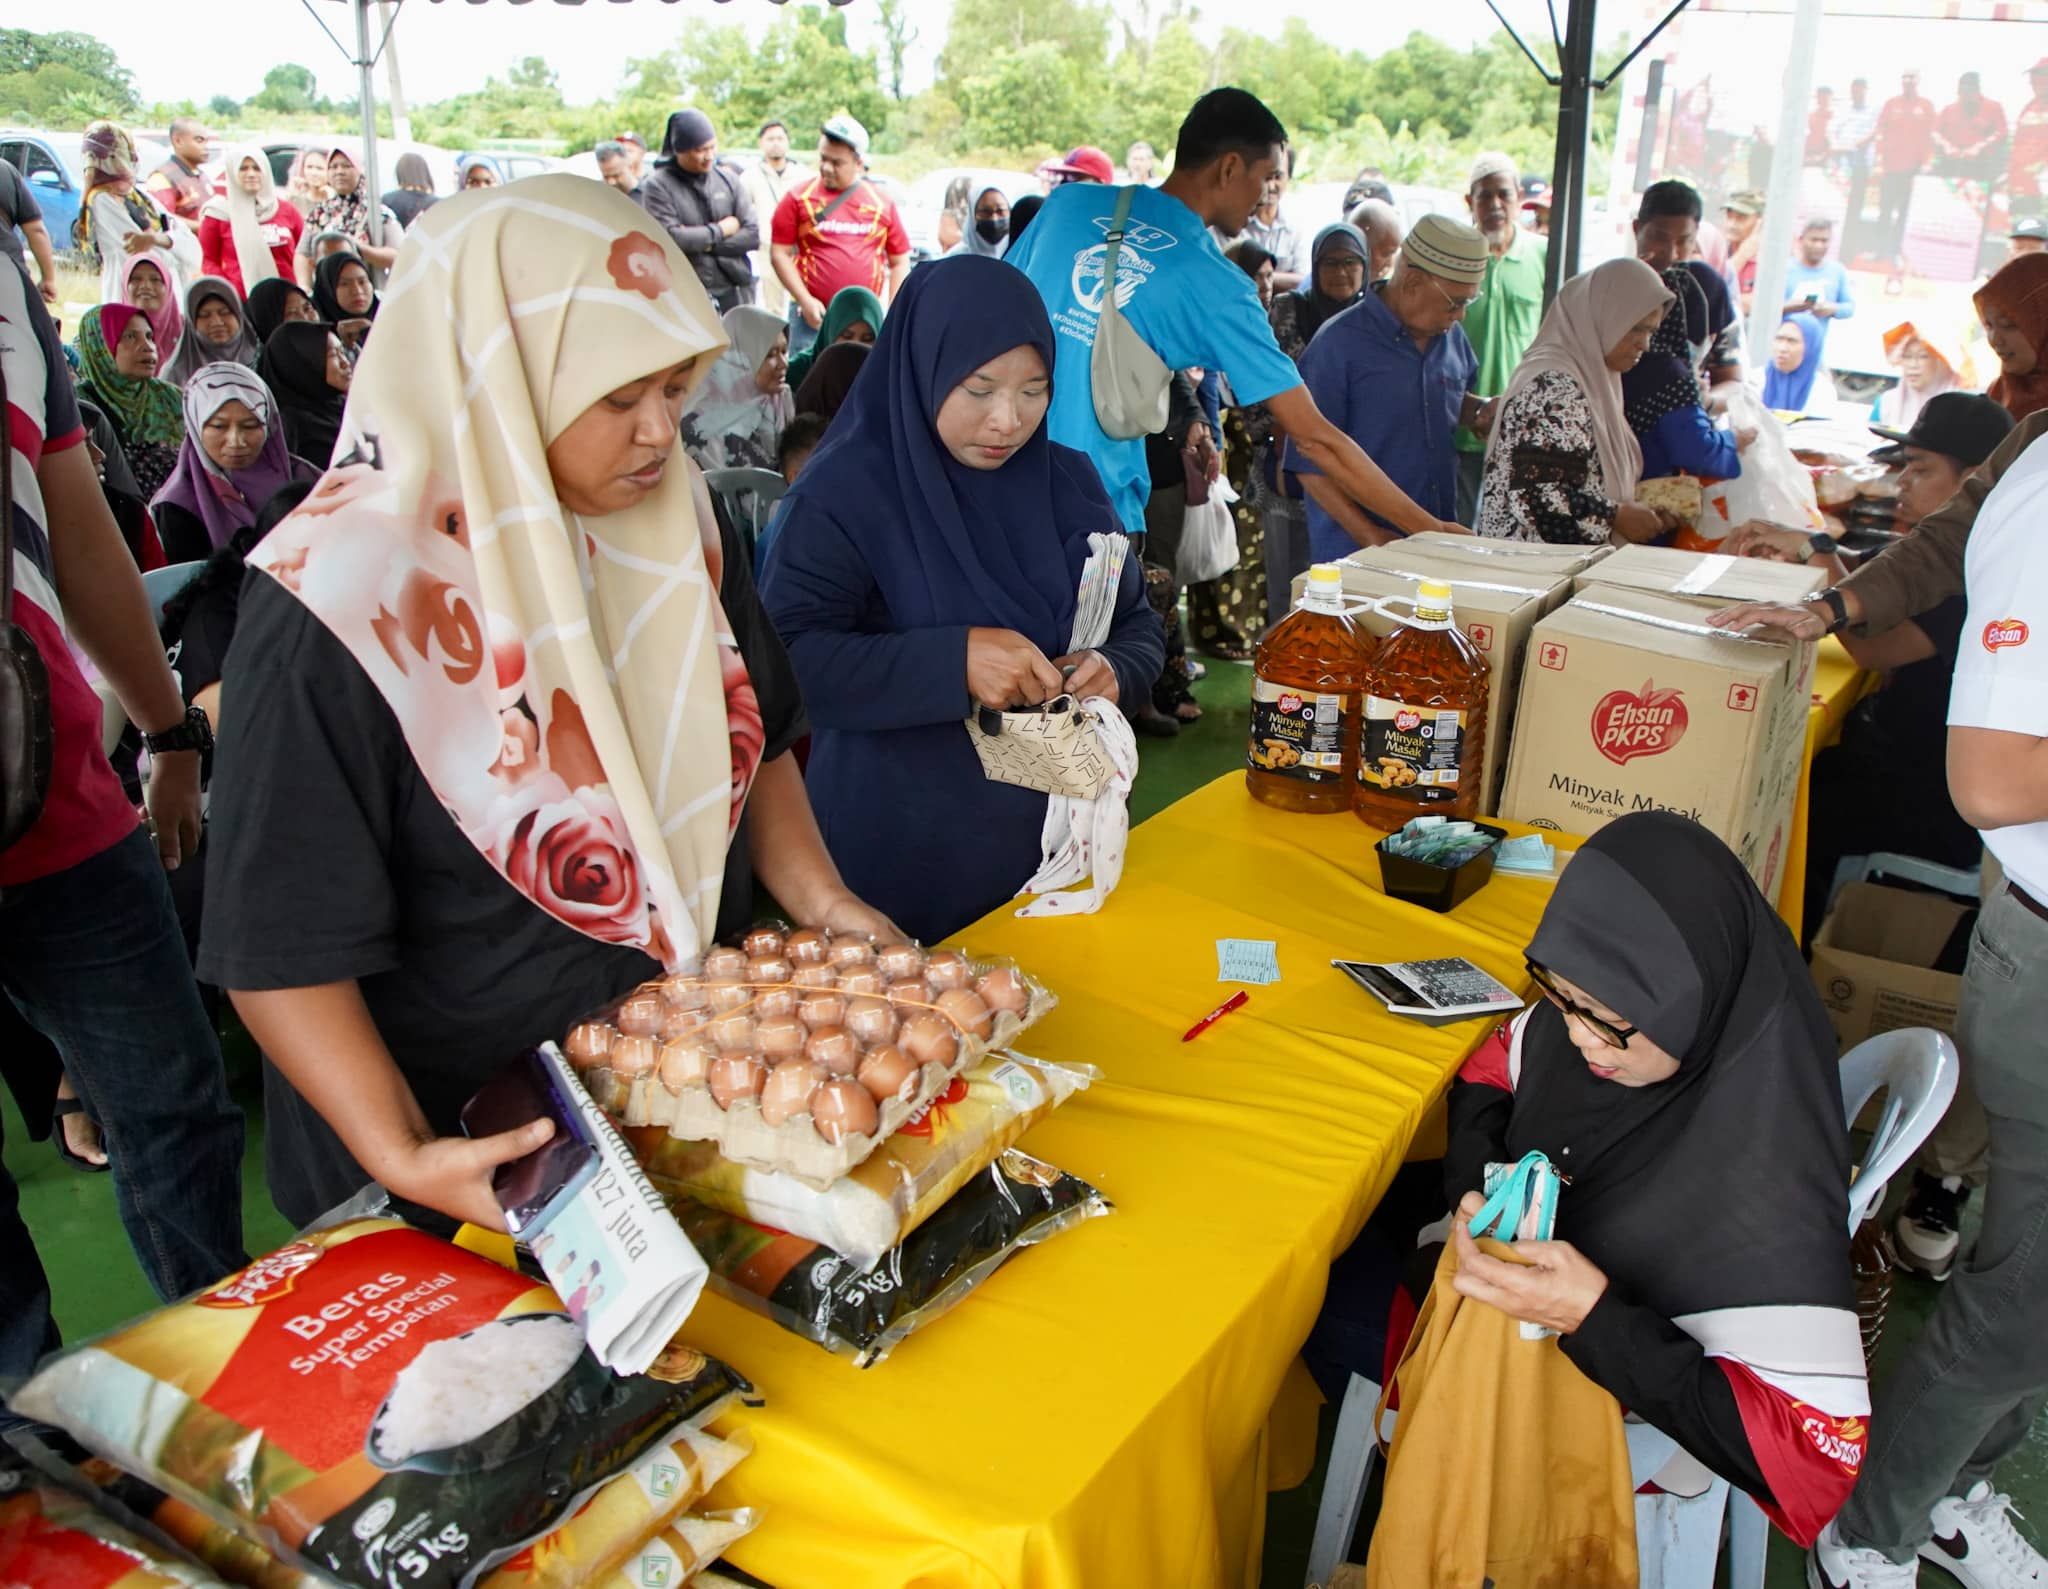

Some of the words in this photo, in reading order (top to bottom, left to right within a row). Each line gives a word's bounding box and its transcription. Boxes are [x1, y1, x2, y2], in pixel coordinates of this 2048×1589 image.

[1268, 711, 1308, 730] Minyak
[1608, 702, 1675, 727] Ehsan
[1270, 722, 1305, 739] Masak
[1384, 729, 1425, 748] Minyak
[1600, 725, 1666, 749] PKPS
[1386, 740, 1422, 758] Masak
[1548, 773, 1625, 807] Minyak
[1570, 800, 1604, 815] Minyak
[605, 1203, 650, 1264] juta
[282, 1271, 408, 1341] Beras
[289, 1320, 370, 1376] Super
[366, 1272, 457, 1324] Special
[331, 1292, 460, 1370] Tempatan
[1802, 1417, 1862, 1467] Ehsan
[396, 1549, 430, 1579] 5
[417, 1521, 470, 1560] kg
